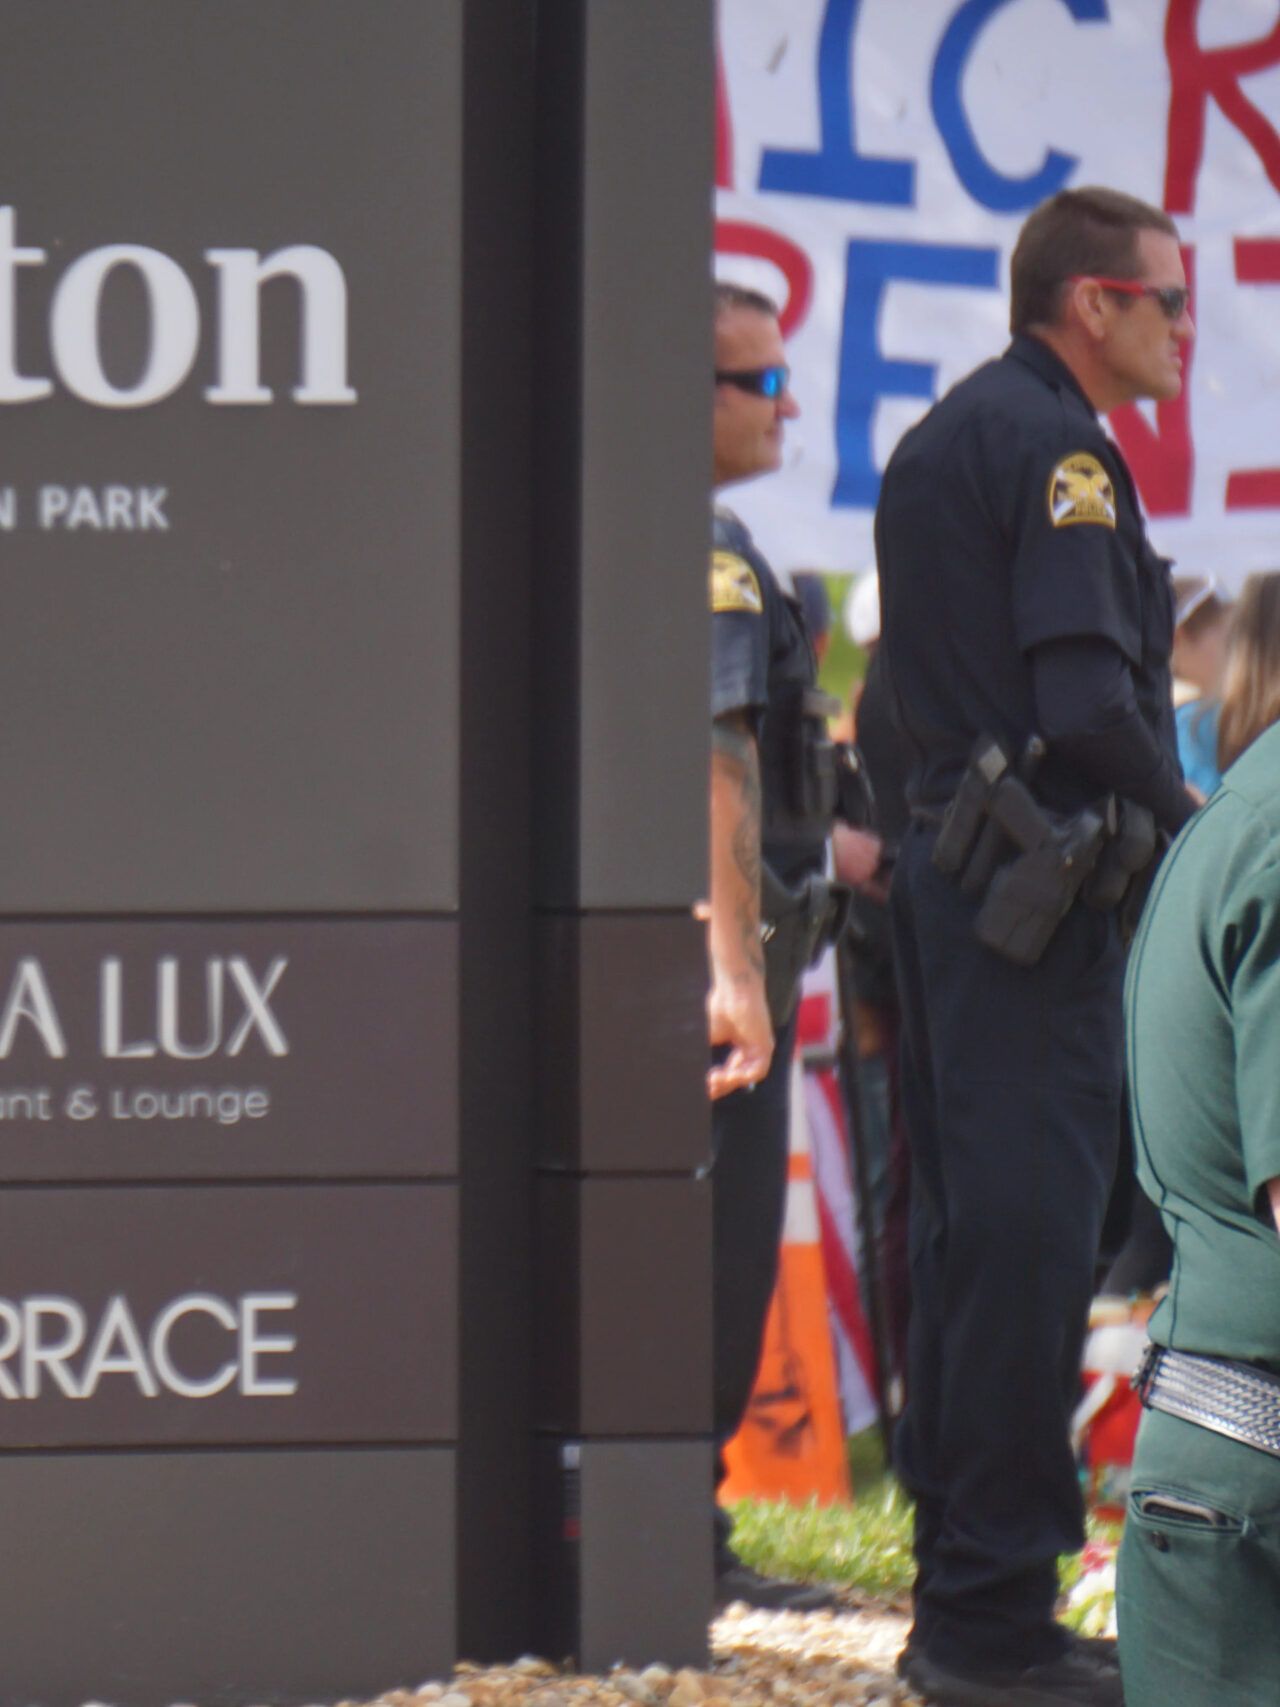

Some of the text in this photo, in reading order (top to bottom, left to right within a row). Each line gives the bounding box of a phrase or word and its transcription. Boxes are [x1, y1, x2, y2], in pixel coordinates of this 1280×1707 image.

[39, 486, 169, 530] PARK
[100, 957, 289, 1059] LUX
[67, 1088, 97, 1121] &
[114, 1088, 270, 1124] Lounge
